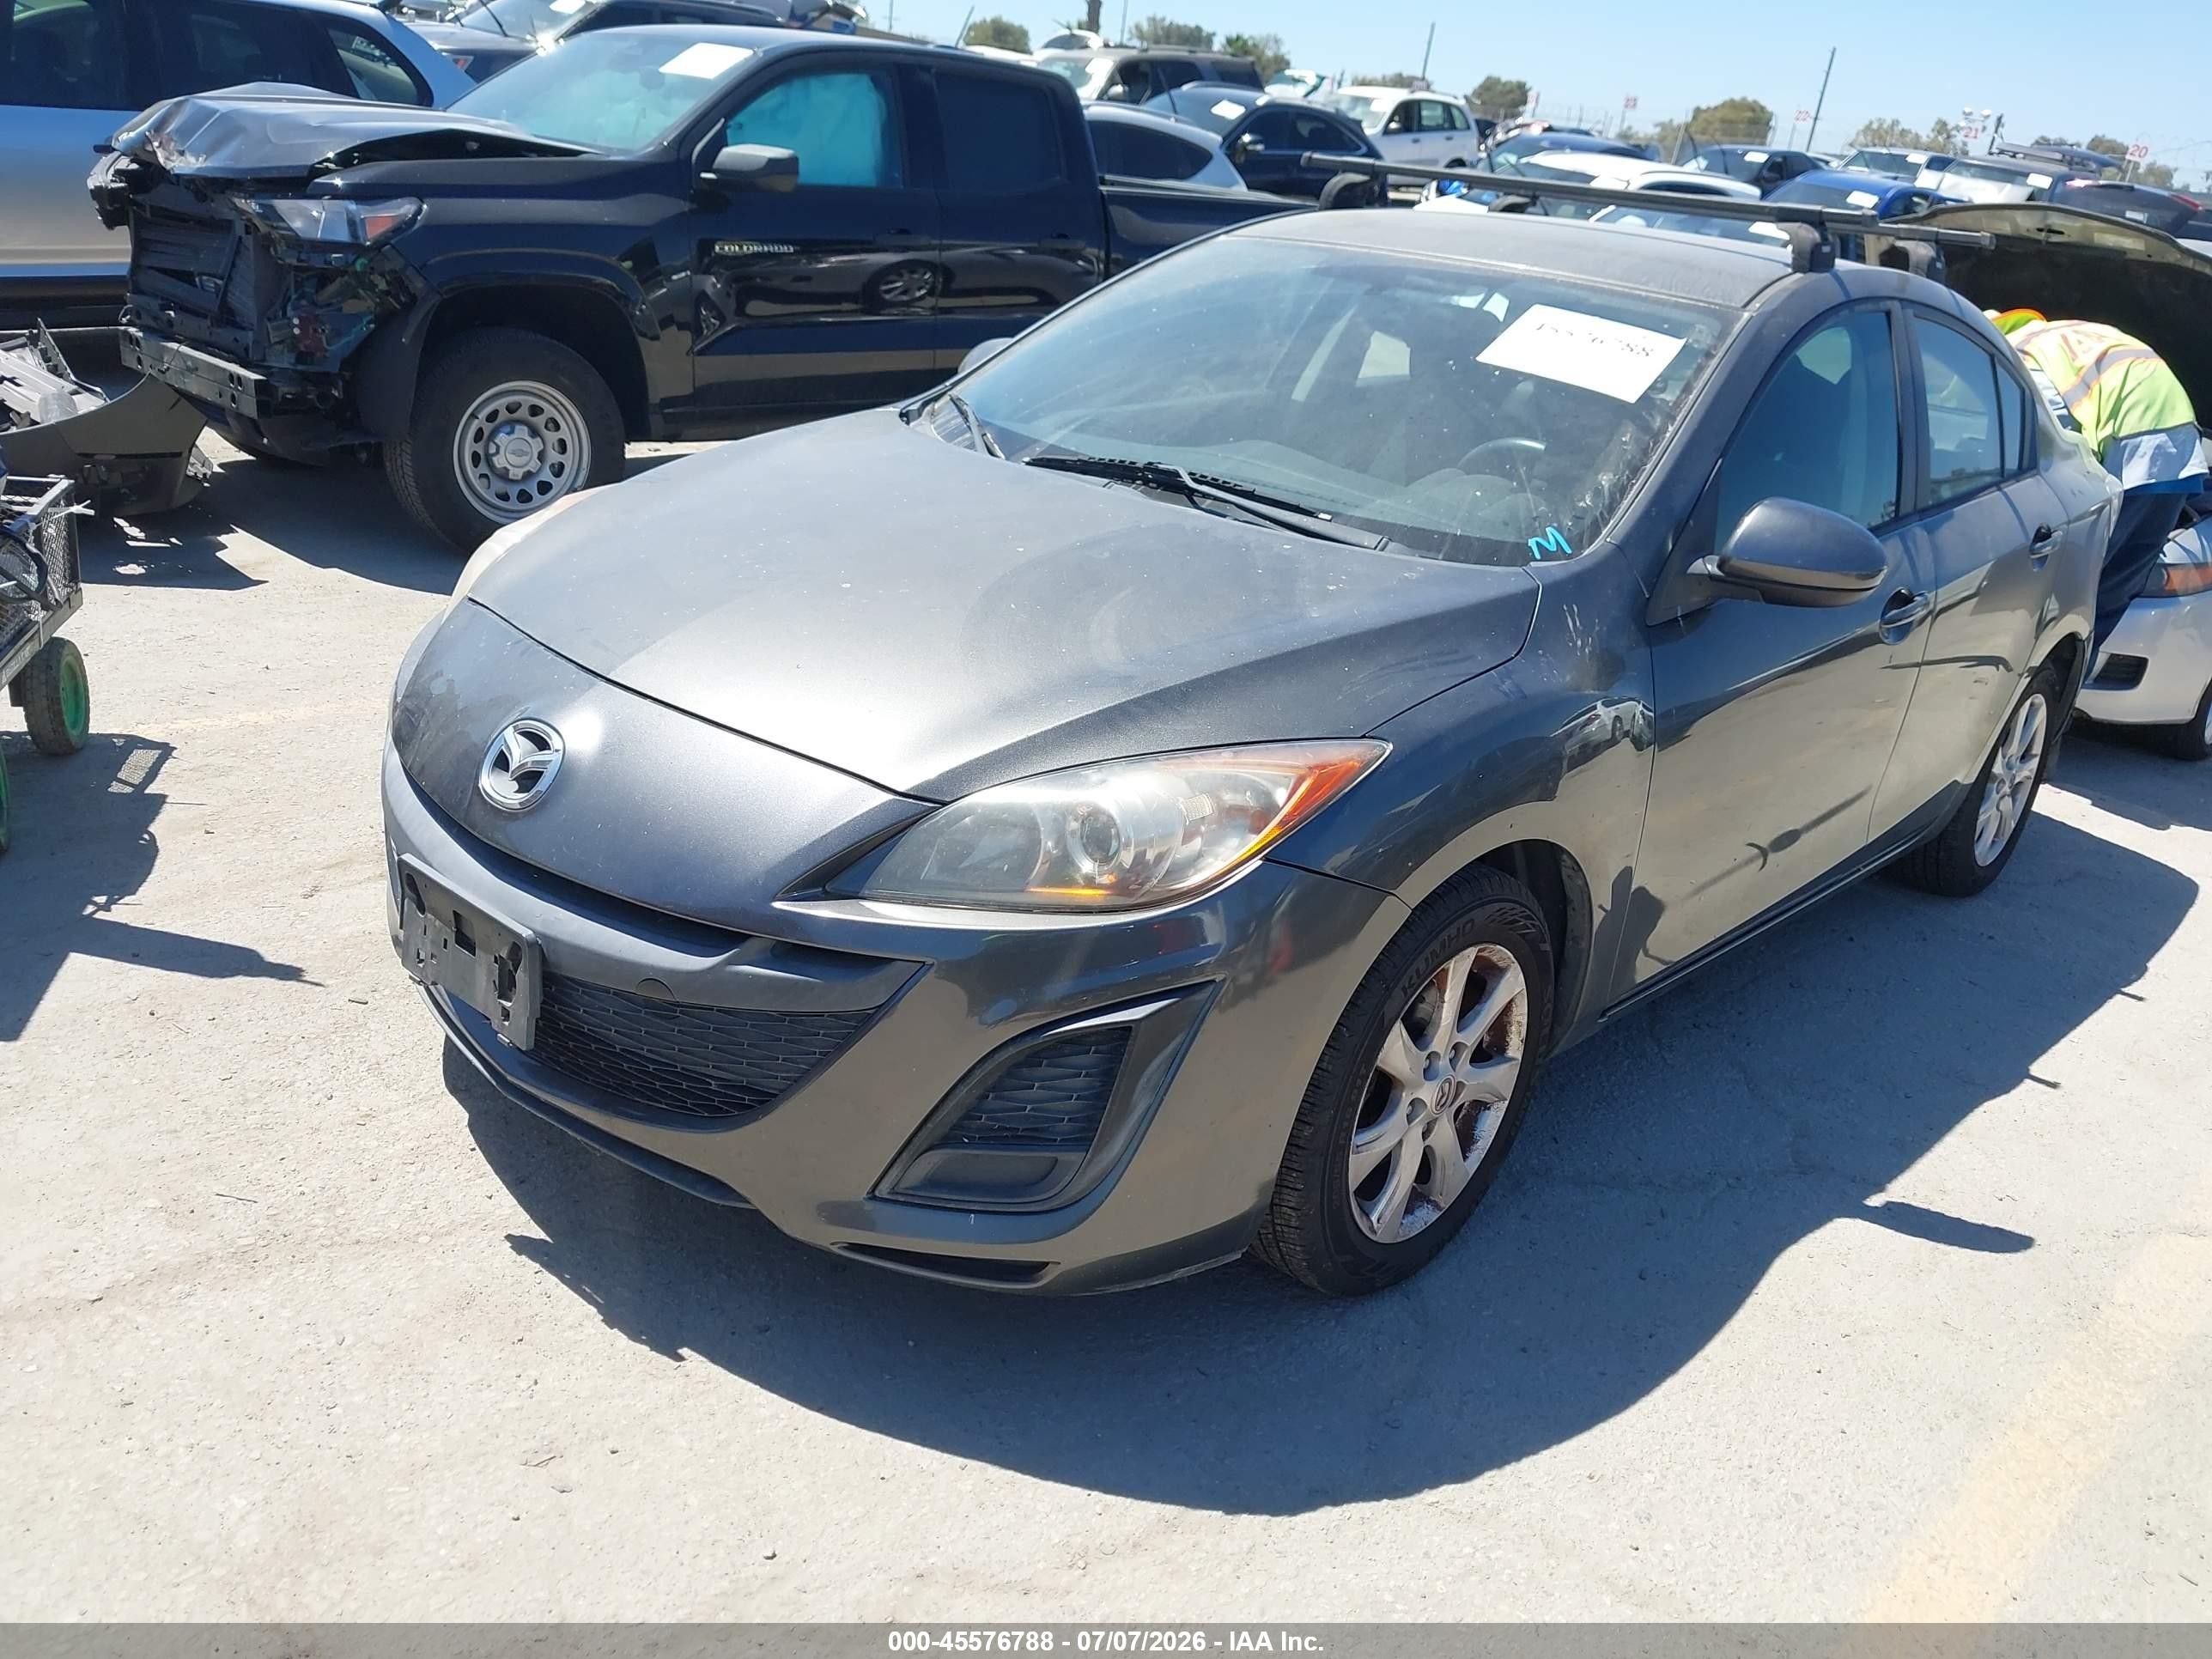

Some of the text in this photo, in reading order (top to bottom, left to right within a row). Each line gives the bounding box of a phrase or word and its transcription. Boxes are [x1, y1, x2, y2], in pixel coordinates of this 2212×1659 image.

[1964, 126, 1978, 138] 21
[2130, 144, 2148, 158] 20
[714, 244, 794, 253] COLORADO
[1528, 526, 1572, 560] M
[1401, 918, 1475, 998] KUMHO
